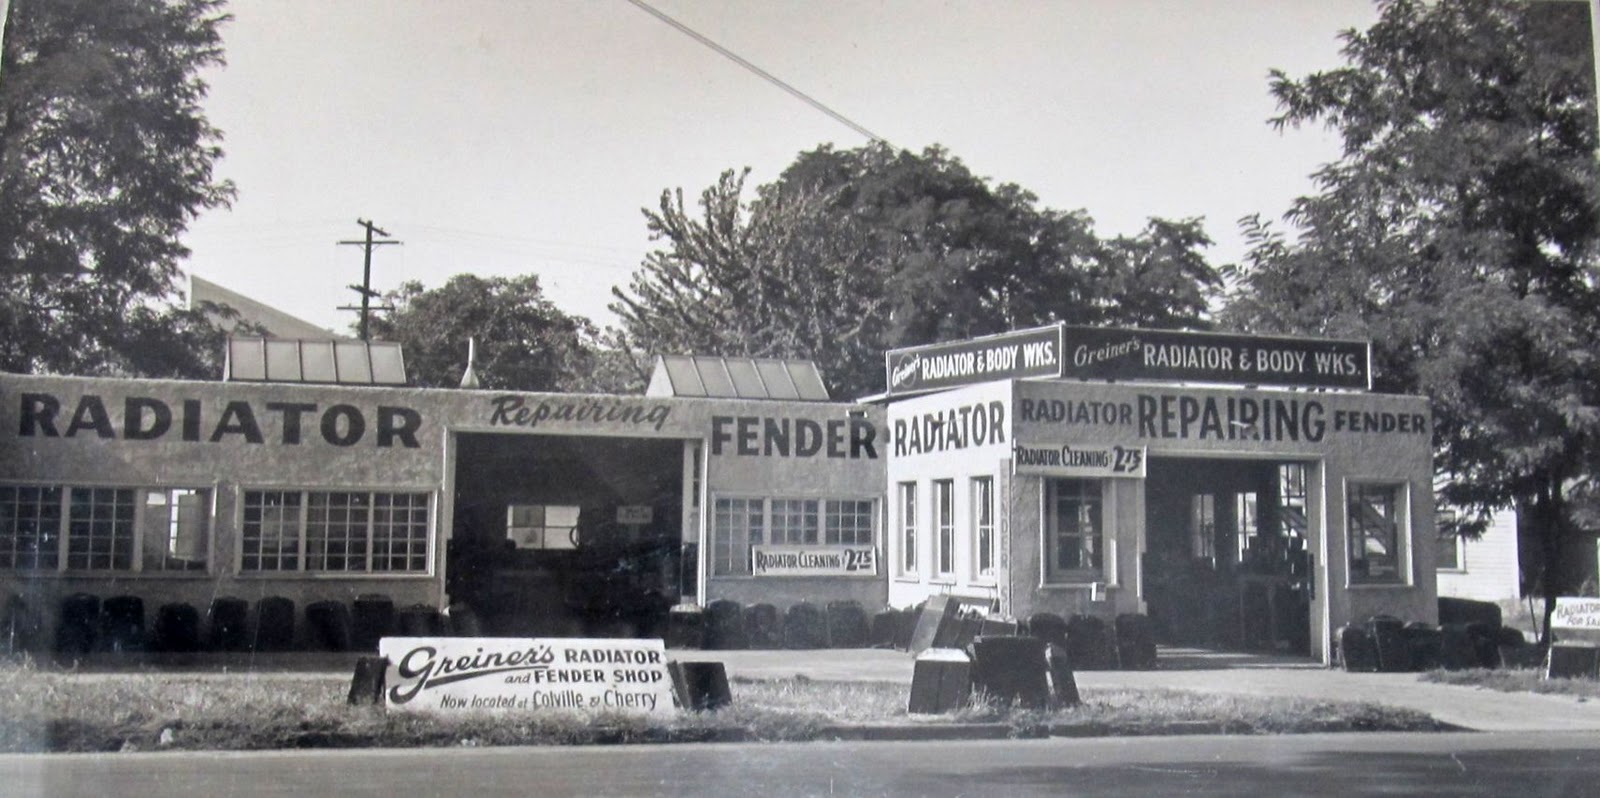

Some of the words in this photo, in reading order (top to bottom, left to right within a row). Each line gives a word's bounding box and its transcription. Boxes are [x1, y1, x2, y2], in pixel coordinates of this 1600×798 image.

[892, 353, 921, 387] Greiner's
[922, 353, 975, 380] RADIATOR
[986, 345, 1019, 372] BODY
[1023, 341, 1057, 368] WKS.
[1074, 337, 1141, 367] Greiner's
[1144, 347, 1233, 370] RADIATOR
[1256, 348, 1306, 373] BODY
[18, 392, 423, 449] RADIATOR
[489, 395, 672, 431] Repairing
[894, 400, 1006, 458] RADIATOR
[1020, 397, 1132, 425] RADIATOR
[1138, 393, 1326, 443] REPAIRING
[1334, 409, 1427, 434] FENDER
[711, 415, 879, 459] FENDER
[1017, 445, 1061, 466] RADIATOR
[1062, 444, 1108, 467] CLEANING
[756, 550, 798, 571] RADIATOR
[798, 551, 840, 568] CLEANING
[389, 646, 555, 704] Greiner's
[565, 649, 661, 664] RADIATOR
[504, 672, 531, 684] and
[534, 669, 606, 684] FENDER
[613, 669, 663, 684] SHOP
[440, 694, 468, 709] Now
[471, 694, 517, 709] located
[518, 698, 528, 709] at
[533, 690, 584, 709] Colville
[604, 689, 658, 711] Cherry
